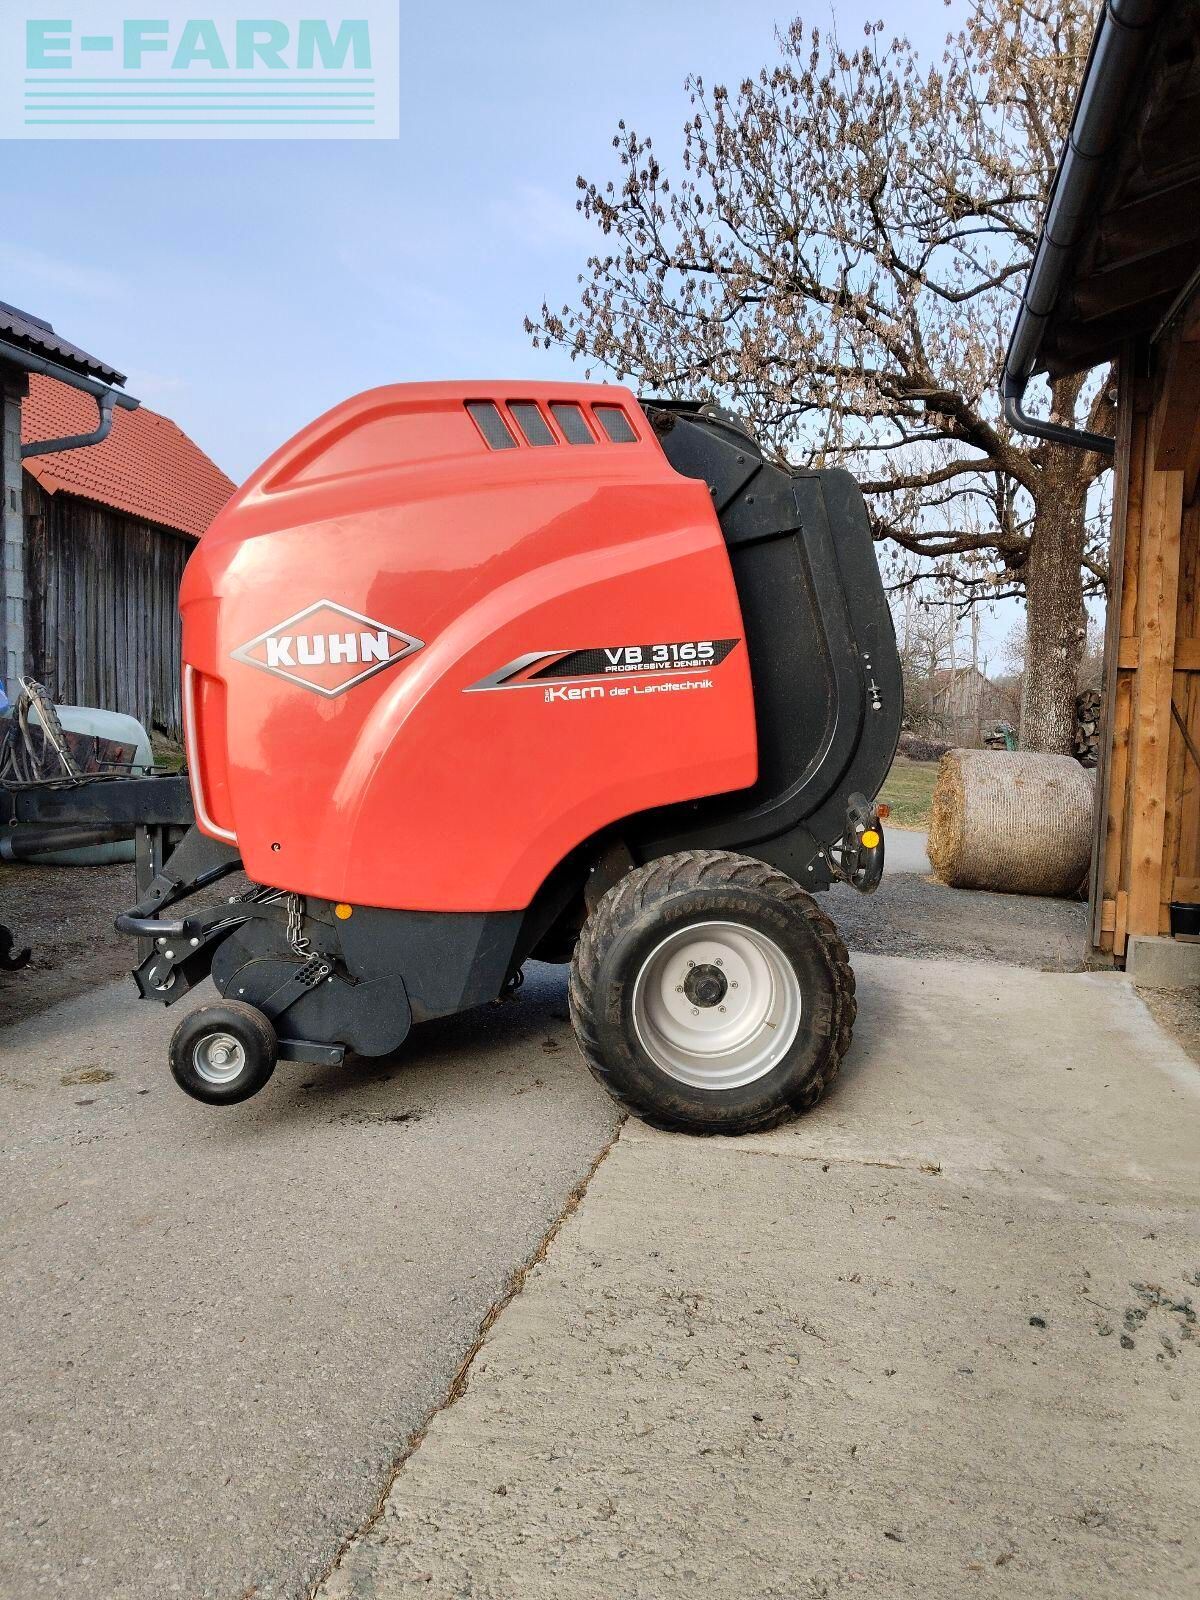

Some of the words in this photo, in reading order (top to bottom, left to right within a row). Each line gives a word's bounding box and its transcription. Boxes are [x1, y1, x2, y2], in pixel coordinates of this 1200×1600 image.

[266, 631, 390, 667] KUHN
[604, 646, 643, 665] VB
[652, 641, 715, 661] 3165
[605, 661, 671, 673] PROGRESSIVE
[673, 658, 714, 668] DENSITY
[549, 685, 605, 702] Kern
[609, 686, 630, 696] der
[634, 679, 714, 694] Landtechnik
